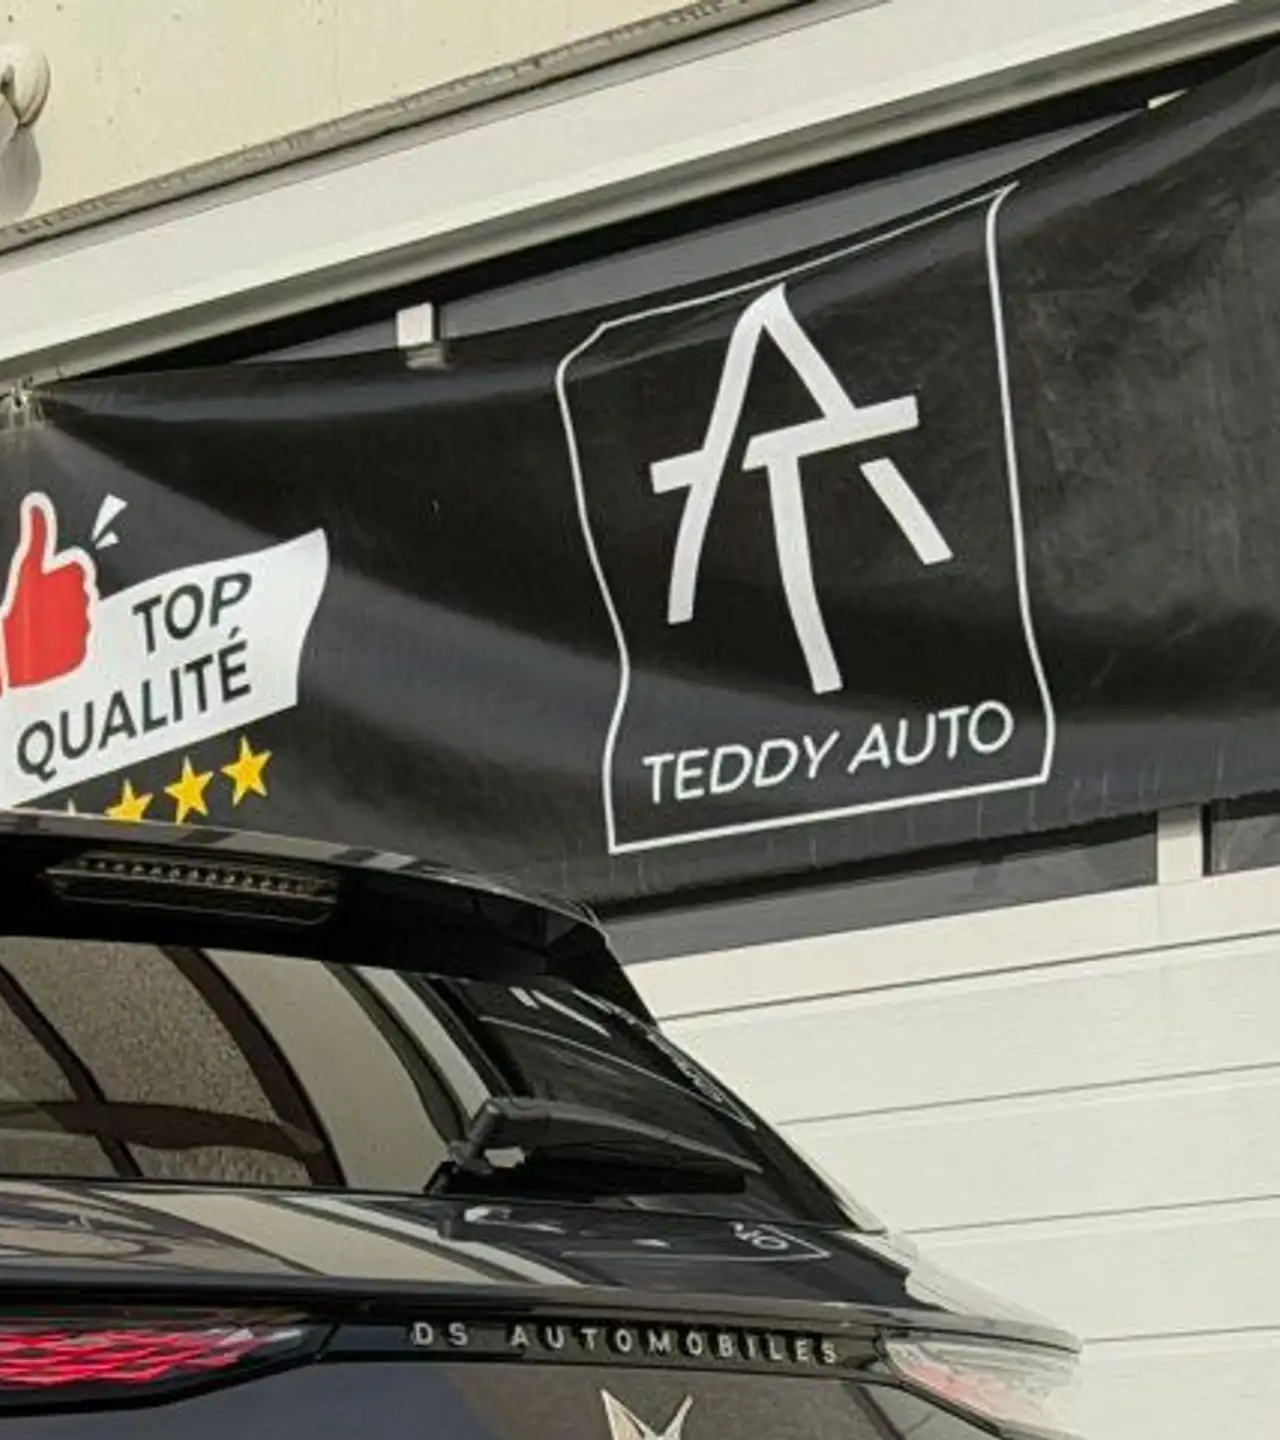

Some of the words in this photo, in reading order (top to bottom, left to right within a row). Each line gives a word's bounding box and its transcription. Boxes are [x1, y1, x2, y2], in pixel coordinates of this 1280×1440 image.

[132, 571, 252, 654] TOP
[16, 627, 252, 782] QUALITÉ
[642, 730, 840, 805] TEDDY
[846, 700, 1015, 775] AUTO
[412, 1321, 470, 1347] DS
[509, 1322, 837, 1365] AUTOMOBILES
